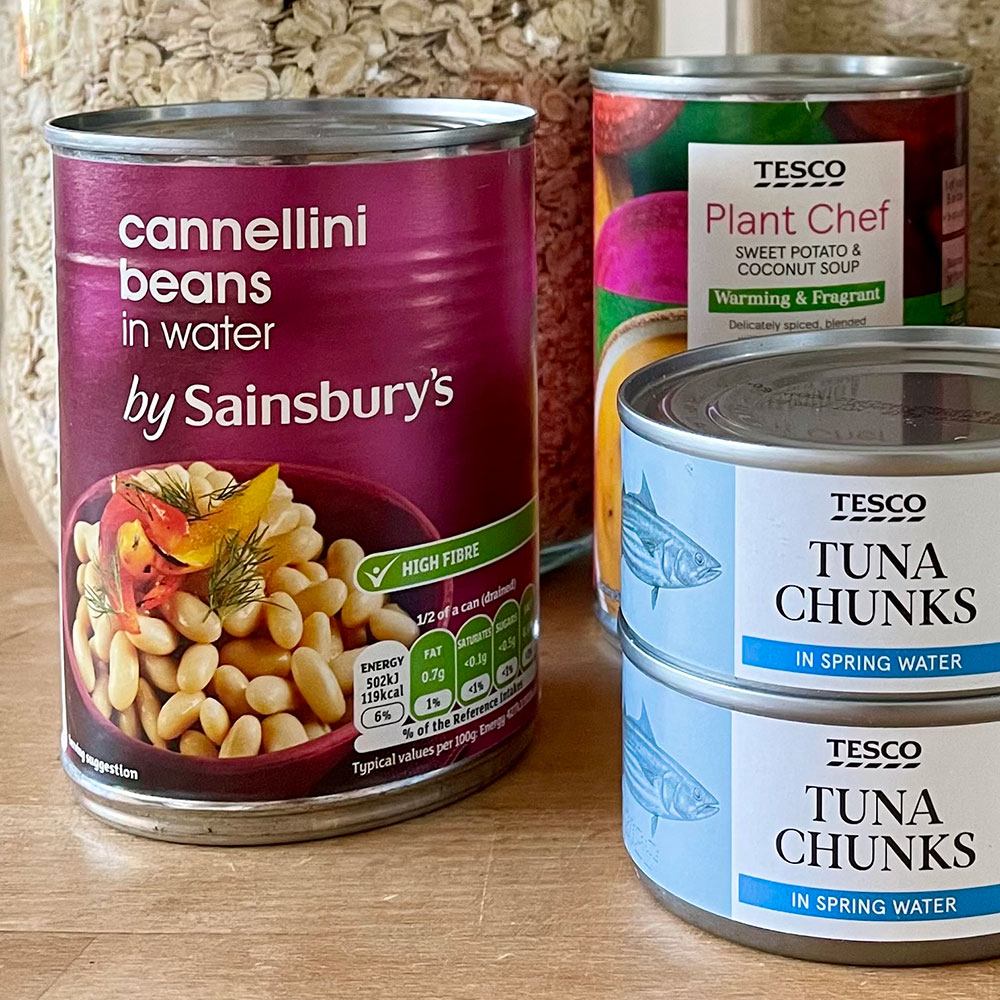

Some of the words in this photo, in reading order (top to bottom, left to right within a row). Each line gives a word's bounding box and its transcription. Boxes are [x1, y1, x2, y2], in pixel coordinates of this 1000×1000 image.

[753, 159, 846, 179] TESCO
[118, 204, 367, 251] cannellini
[706, 202, 796, 235] Plant
[808, 199, 891, 234] Chef
[735, 245, 785, 260] SWEET
[790, 244, 848, 259] POTATO
[853, 243, 862, 256] &
[737, 261, 816, 277] COCONUT
[820, 260, 860, 275] SOUP
[119, 258, 272, 304] beans
[714, 290, 791, 309] Warming
[796, 290, 807, 304] &
[812, 287, 881, 307] Fragrant
[121, 310, 149, 348] in
[161, 315, 275, 350] water
[729, 319, 780, 332] Delicately
[825, 317, 867, 329] blended
[122, 374, 176, 441] by
[184, 367, 454, 427] Sainsbury's
[830, 492, 927, 514] TESCO
[402, 554, 439, 577] HIGH
[442, 542, 480, 567] FIBRE
[809, 540, 948, 581] TUNA
[416, 611, 435, 626] 1/2
[437, 607, 450, 621] of
[452, 606, 459, 616] a
[461, 598, 480, 613] can
[775, 584, 978, 626] CHUNKS
[424, 645, 443, 660] FAT
[463, 652, 487, 668] <0.1g
[796, 651, 814, 668] IN
[820, 653, 892, 672] SPRING
[898, 653, 963, 672] WATER
[360, 656, 405, 674] ENERGY
[421, 667, 445, 684] 0.7g
[366, 672, 399, 690] 502kJ
[468, 681, 484, 694] <1%
[361, 685, 404, 705] 119kcal
[426, 697, 441, 710] 1%
[374, 710, 392, 723] 6%
[402, 727, 414, 740] %
[417, 721, 431, 737] of
[432, 717, 451, 732] the
[453, 696, 499, 728] Reference
[352, 753, 396, 776] Typical
[398, 744, 435, 764] values
[436, 739, 453, 757] per
[826, 738, 923, 760] TESCO
[86, 753, 138, 780] suggestion
[805, 785, 944, 825] TUNA
[775, 827, 977, 872] CHUNKS
[791, 892, 810, 910] IN
[816, 895, 886, 915] SPRING
[892, 895, 958, 915] WATER
